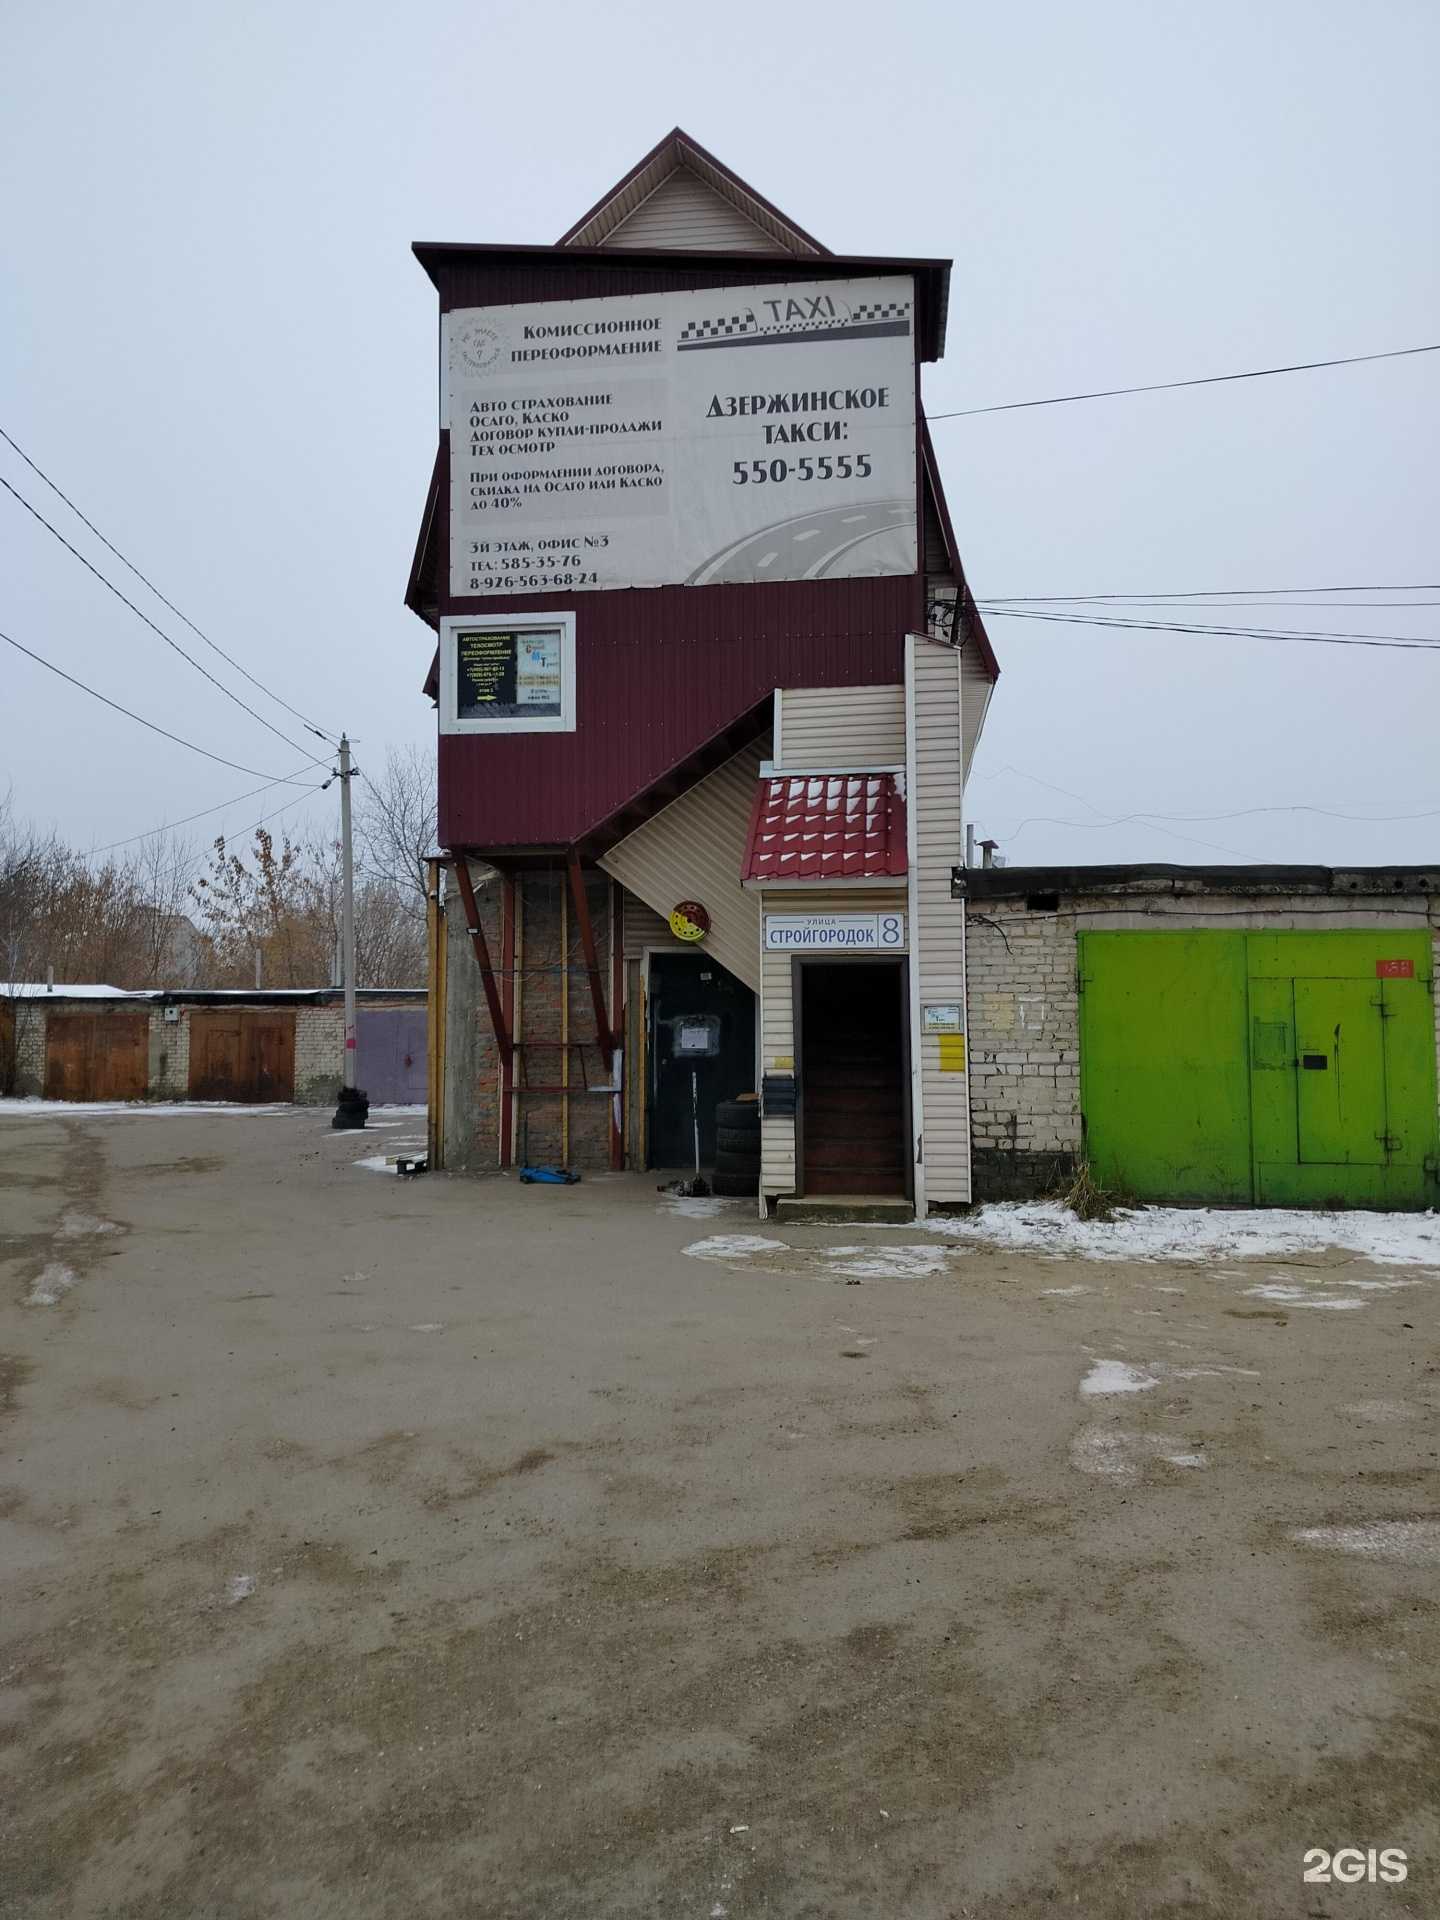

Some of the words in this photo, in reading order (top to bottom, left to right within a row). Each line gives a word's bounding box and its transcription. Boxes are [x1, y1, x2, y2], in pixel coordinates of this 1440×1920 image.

[763, 296, 836, 322] TAXI
[524, 318, 662, 339] КОМИССИОННОЕ
[511, 340, 662, 362] ПЕРЕОФОРМЛЕНИЕ
[511, 394, 613, 411] СТРАХОВАНИЕ
[705, 388, 889, 418] ДЗЕРЖИНСКОЕ
[522, 411, 569, 424] КАСКО
[470, 428, 534, 442] ДОГОВОР
[762, 421, 849, 445] ТАКСИ:
[499, 442, 555, 455] ОСМОТР
[470, 472, 498, 483] ПРИ
[732, 454, 872, 485] 550-5555
[470, 485, 520, 497] СКИДКА
[523, 484, 541, 494] НА
[544, 480, 585, 493] ОСАГО
[589, 479, 616, 490] ИЛИ
[620, 476, 663, 488] КАСКО
[491, 497, 522, 509] 40%
[538, 537, 580, 550] ОФИС
[501, 554, 581, 570] 585-35-76
[470, 572, 598, 590] 8-926-563-68-24
[806, 918, 836, 926] УЛИЦА
[882, 918, 900, 944] 8
[770, 927, 874, 945] СТРОЙГОРОДОК
